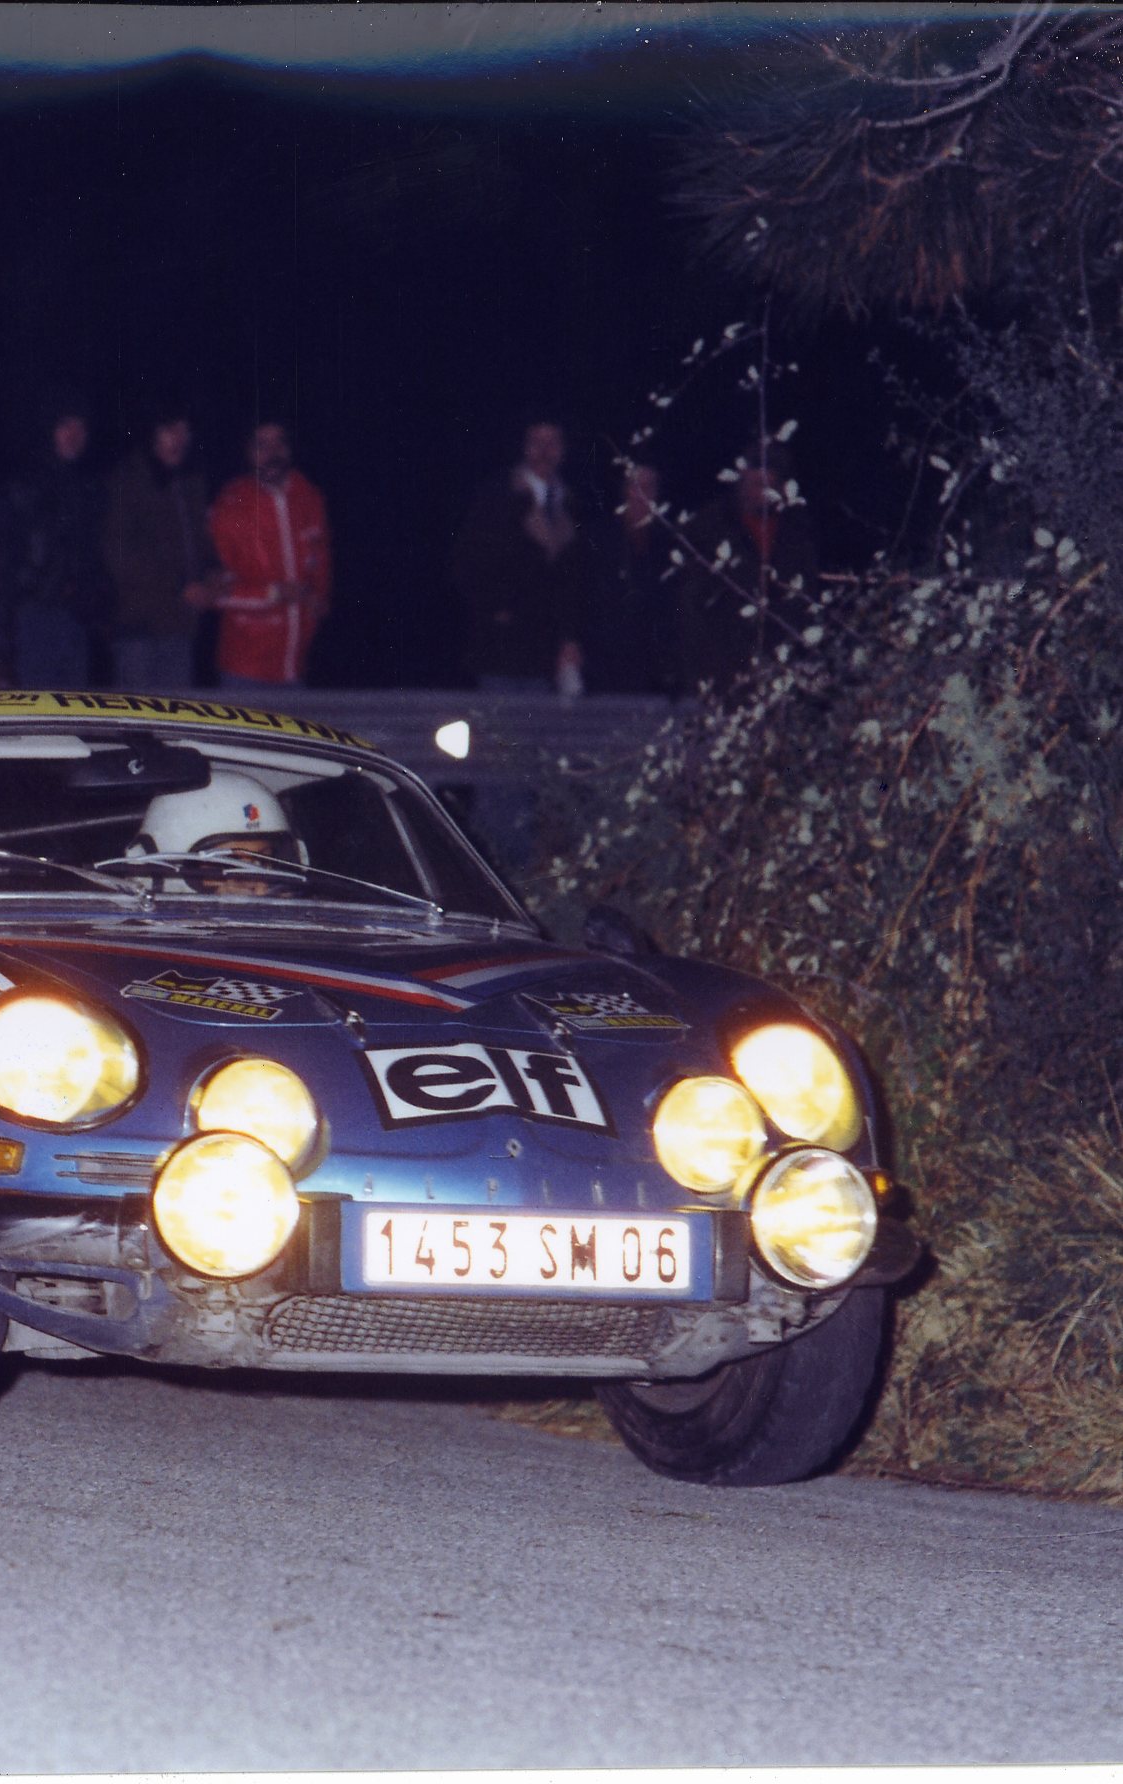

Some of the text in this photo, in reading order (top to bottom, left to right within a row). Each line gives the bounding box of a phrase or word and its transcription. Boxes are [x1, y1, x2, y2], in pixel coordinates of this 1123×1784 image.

[385, 1046, 581, 1118] elf
[380, 1219, 508, 1280] 1453
[622, 1225, 677, 1284] 06
